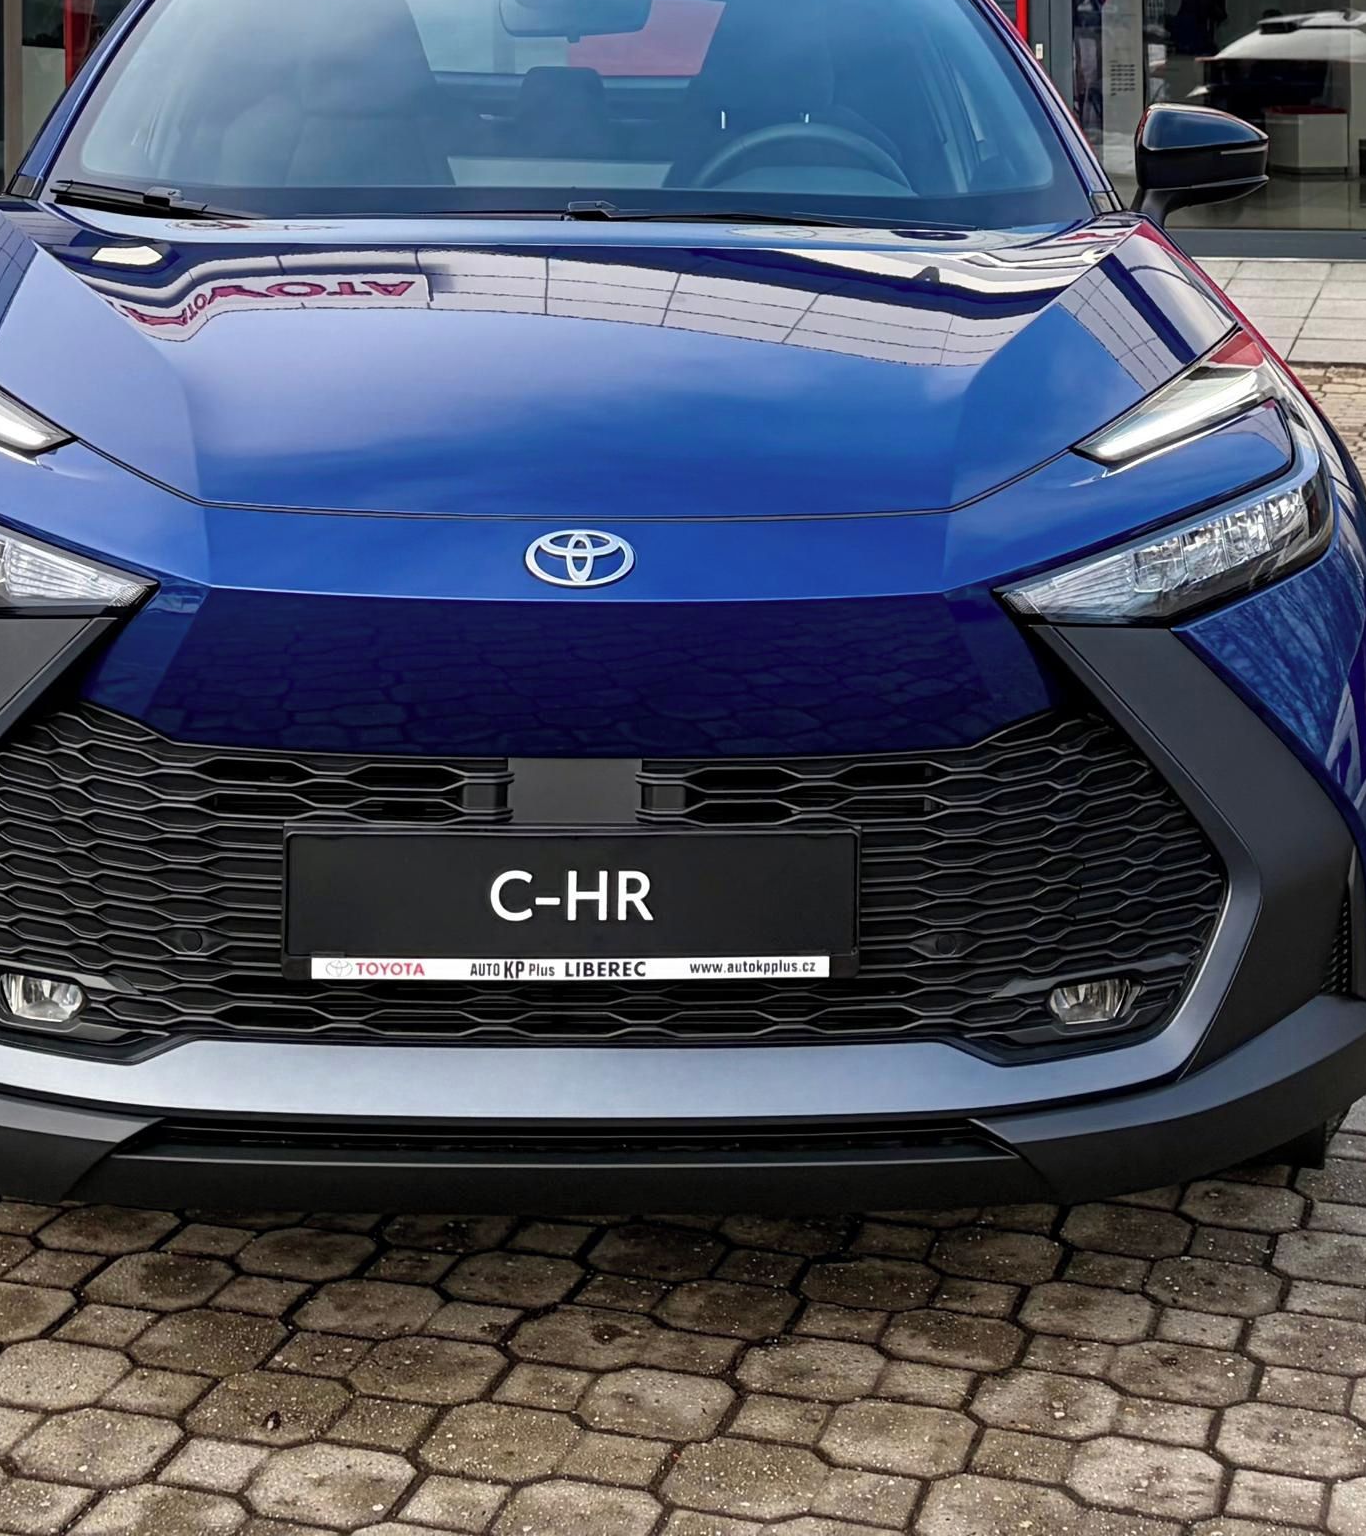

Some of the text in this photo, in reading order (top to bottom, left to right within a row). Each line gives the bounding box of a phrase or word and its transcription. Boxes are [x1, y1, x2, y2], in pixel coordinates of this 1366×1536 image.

[489, 870, 654, 922] C-HR
[355, 960, 816, 979] TOYOTA AUTO KP Plus LIBEREC www.autokpplus.cz
